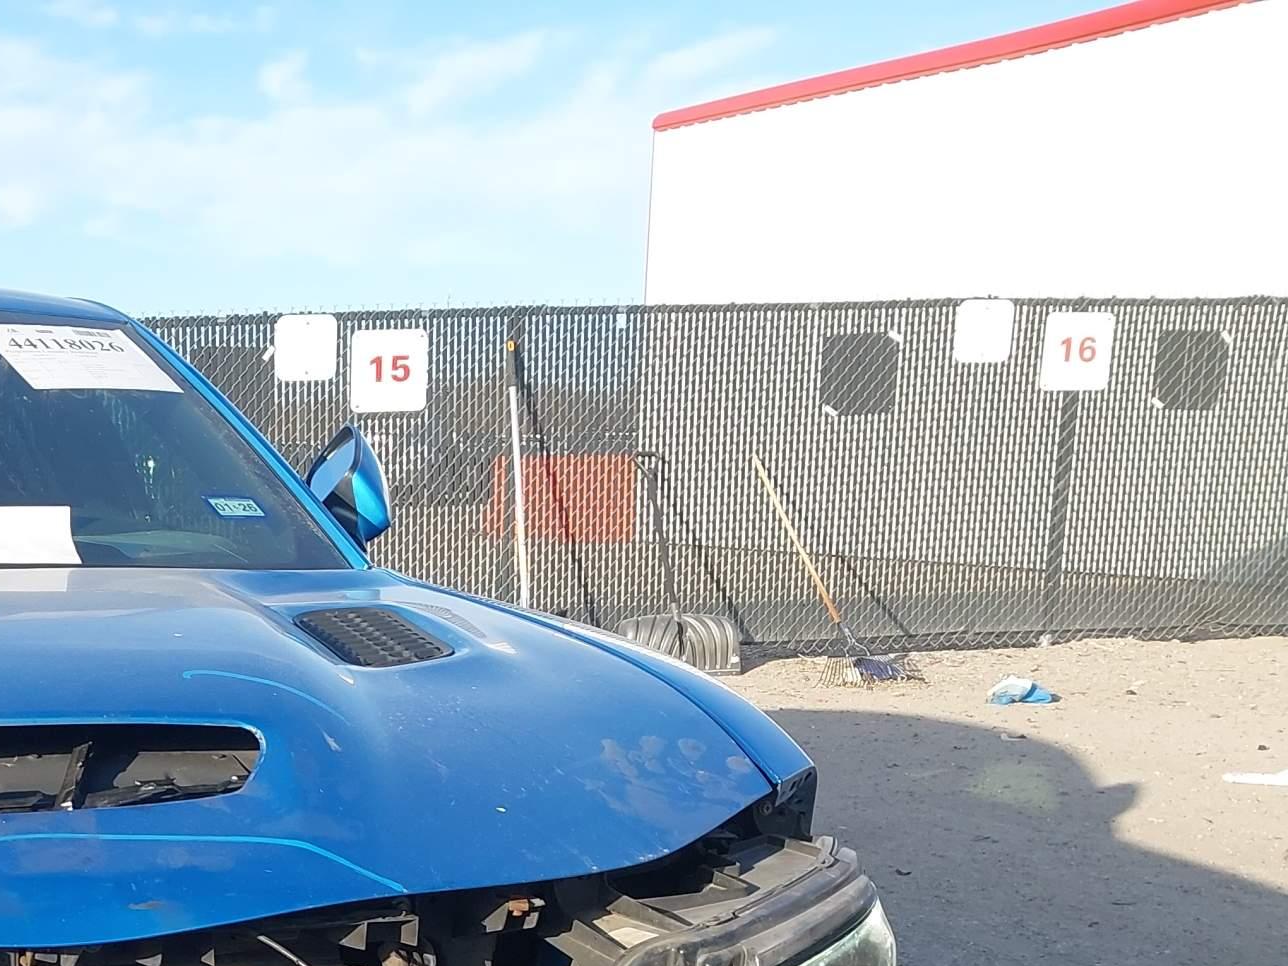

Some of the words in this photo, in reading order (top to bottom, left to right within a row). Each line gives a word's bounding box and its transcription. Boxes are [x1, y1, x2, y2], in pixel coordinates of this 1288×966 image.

[8, 336, 125, 353] 44118026
[1060, 336, 1097, 363] 16
[369, 355, 411, 383] 15
